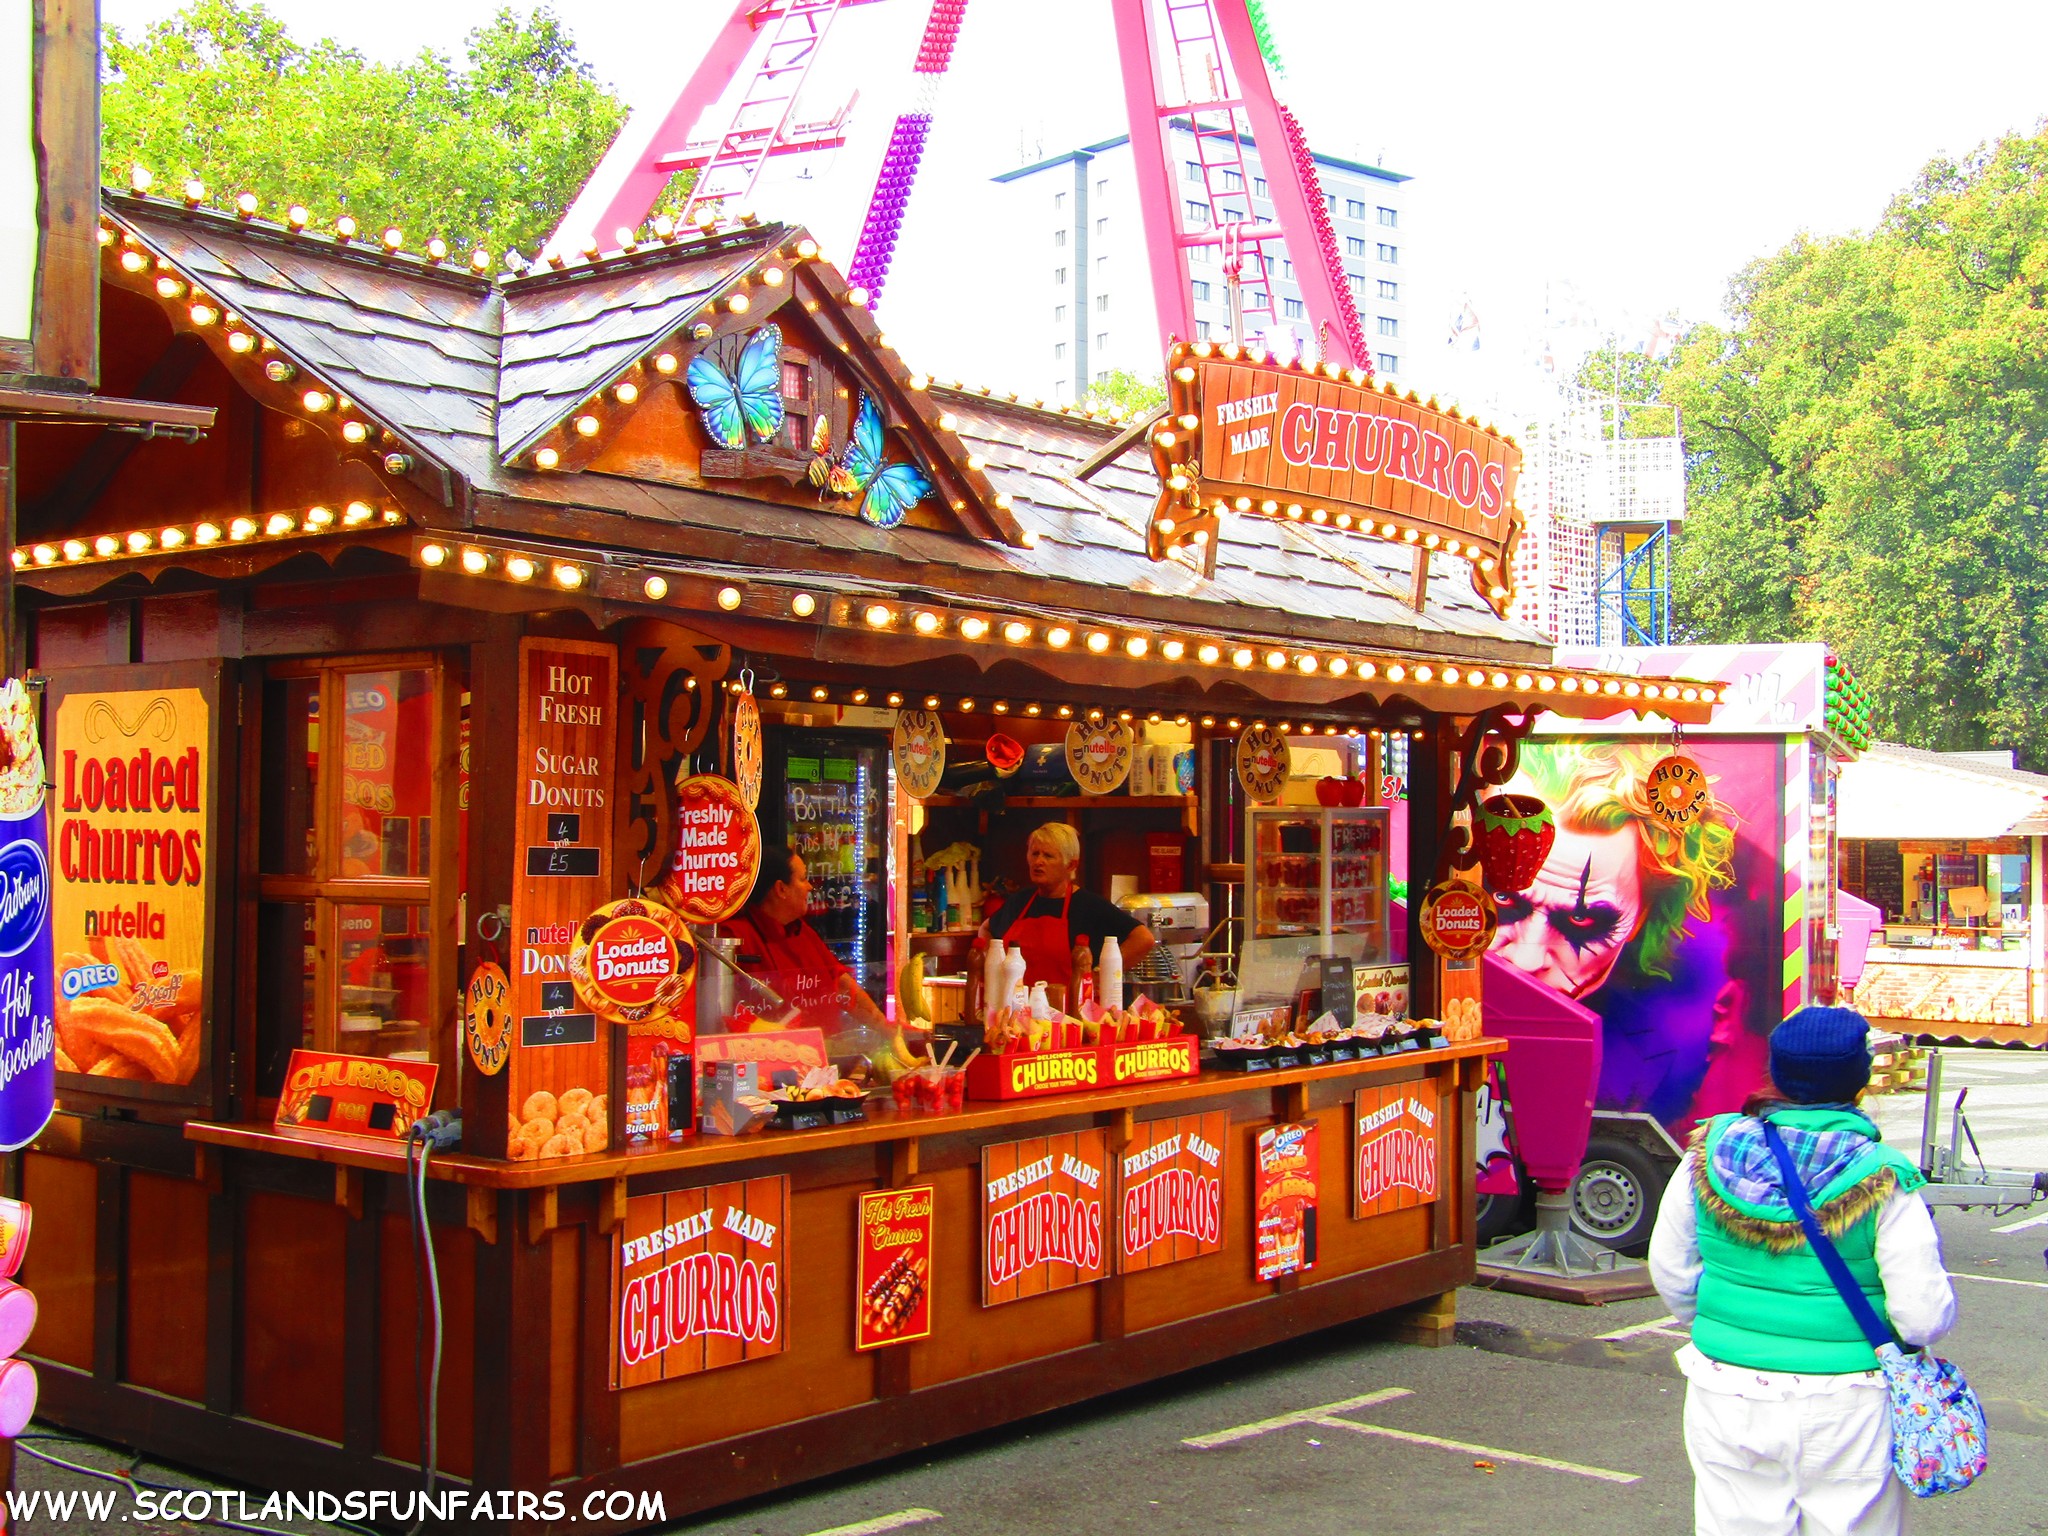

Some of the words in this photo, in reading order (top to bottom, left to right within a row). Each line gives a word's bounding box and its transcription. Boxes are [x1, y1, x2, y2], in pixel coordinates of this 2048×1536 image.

[1216, 392, 1279, 426] FRESHLY
[1230, 426, 1269, 456] MADE
[1281, 402, 1504, 519] CHURROS
[548, 665, 592, 696] HOT
[539, 695, 602, 727] FRESH
[1084, 741, 1117, 755] nutella
[1246, 729, 1285, 755] HOT
[536, 746, 599, 777] SUGAR
[1073, 746, 1127, 785] DONUTS
[1242, 757, 1286, 793] DONUTS
[1655, 764, 1699, 785] HOT
[62, 747, 200, 813] Loaded
[529, 779, 604, 808] DONUTS
[678, 804, 733, 826] Freshly
[1648, 787, 1706, 823] DONUTS
[60, 819, 202, 887] Churros
[681, 827, 728, 849] Made
[673, 852, 738, 872] Churros
[684, 874, 725, 893] Here
[85, 902, 165, 940] nutella
[1436, 905, 1479, 918] Loaded
[1436, 917, 1480, 931] Donuts
[527, 921, 579, 945] nutell
[597, 936, 667, 961] Loaded
[521, 948, 571, 976] DON
[597, 955, 670, 981] Donuts
[63, 965, 119, 996] OREO
[130, 973, 182, 1012] Biscoff
[471, 974, 506, 1006] HOT
[796, 975, 821, 990] Hot
[2, 968, 35, 1039] Hot
[734, 999, 773, 1020] fresh
[790, 991, 852, 1010] Churros
[467, 1011, 512, 1067] DONUTS
[1137, 1042, 1168, 1051] DELICIOUS
[1036, 1052, 1073, 1061] DELICIOUS
[1115, 1047, 1190, 1081] CHURROS
[290, 1061, 426, 1107] CHURROS
[1012, 1057, 1097, 1093] CHURROS
[626, 1099, 660, 1113] iscoff
[1359, 1098, 1404, 1135] FRESHLY
[1408, 1097, 1434, 1128] MADE
[1275, 1129, 1303, 1148] OREO
[1123, 1134, 1182, 1178] FRESHLY
[1186, 1132, 1220, 1168] MADE
[1268, 1154, 1307, 1174] LOADED
[1359, 1128, 1435, 1203] CHURROS
[987, 1155, 1054, 1202] FRESHLY
[1059, 1152, 1100, 1190] MADE
[865, 1198, 893, 1226] Hot
[894, 1194, 931, 1221] Fresh
[1259, 1178, 1317, 1211] CHURROS
[1122, 1167, 1220, 1256] CHURROS
[622, 1208, 714, 1266] FRESHLY
[723, 1206, 777, 1249] MADE
[870, 1224, 923, 1251] Churros
[987, 1191, 1101, 1287] CHURROS
[621, 1252, 778, 1366] CHURROS
